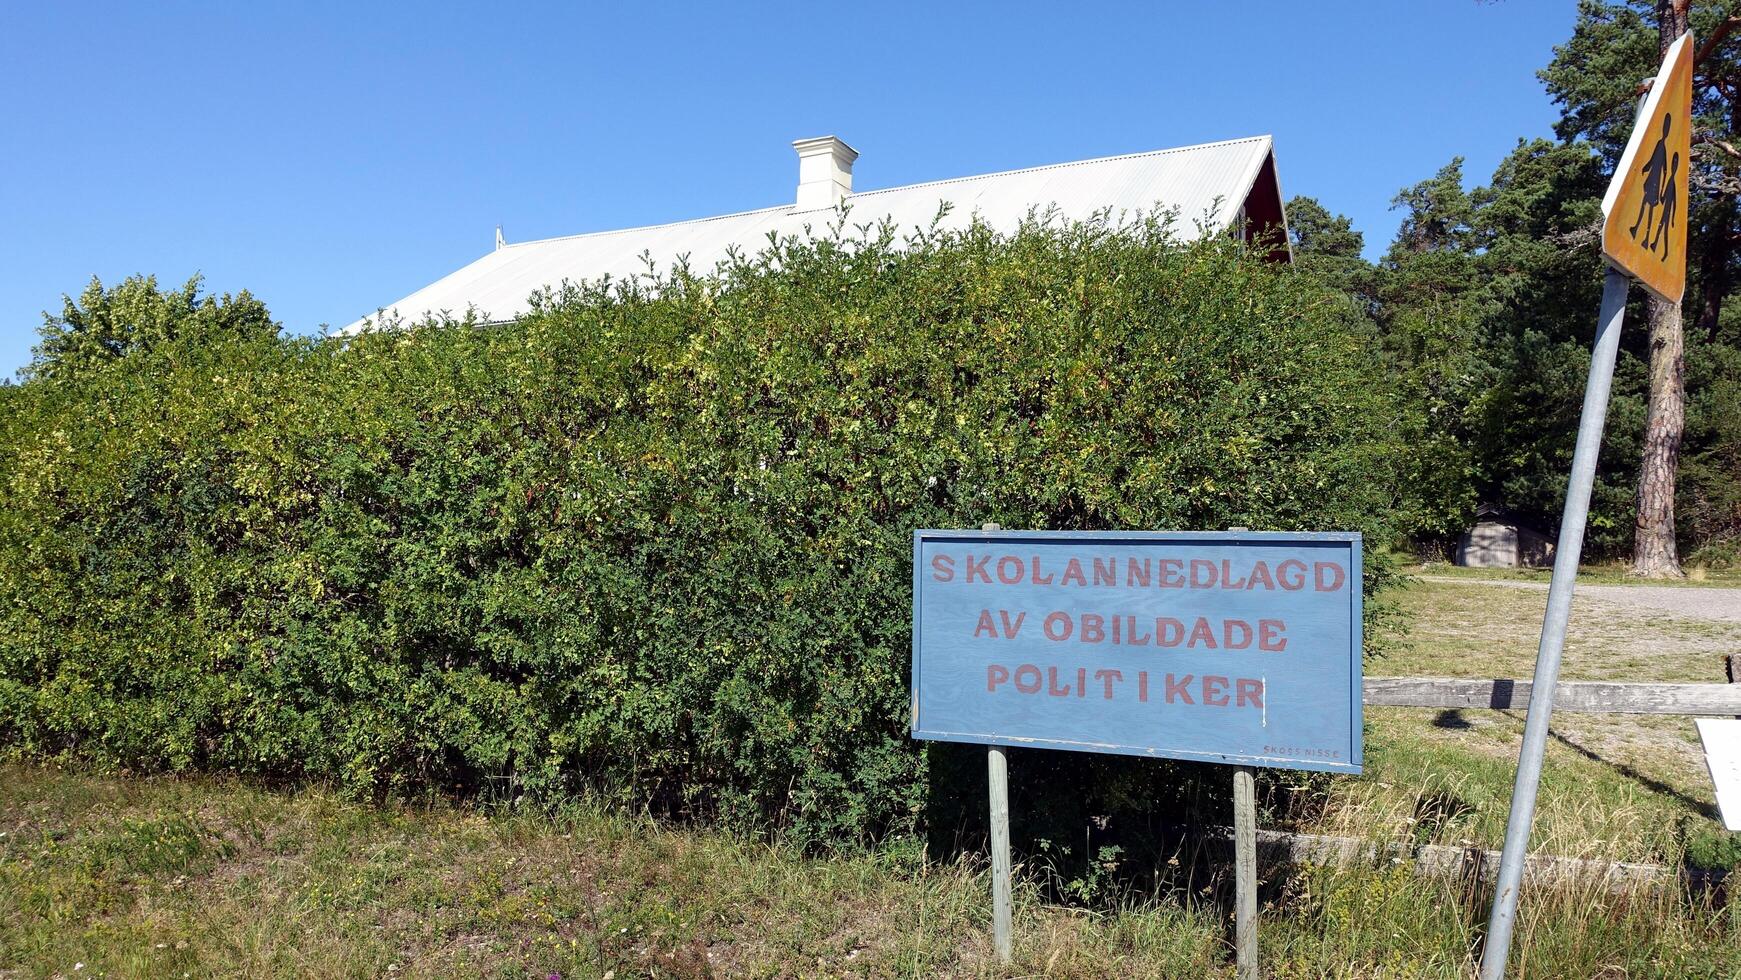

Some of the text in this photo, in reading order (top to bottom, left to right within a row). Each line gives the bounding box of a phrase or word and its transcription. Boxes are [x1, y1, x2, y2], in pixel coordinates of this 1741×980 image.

[974, 609, 1288, 652] AV OBILDADE
[987, 664, 1265, 708] POLITIKER
